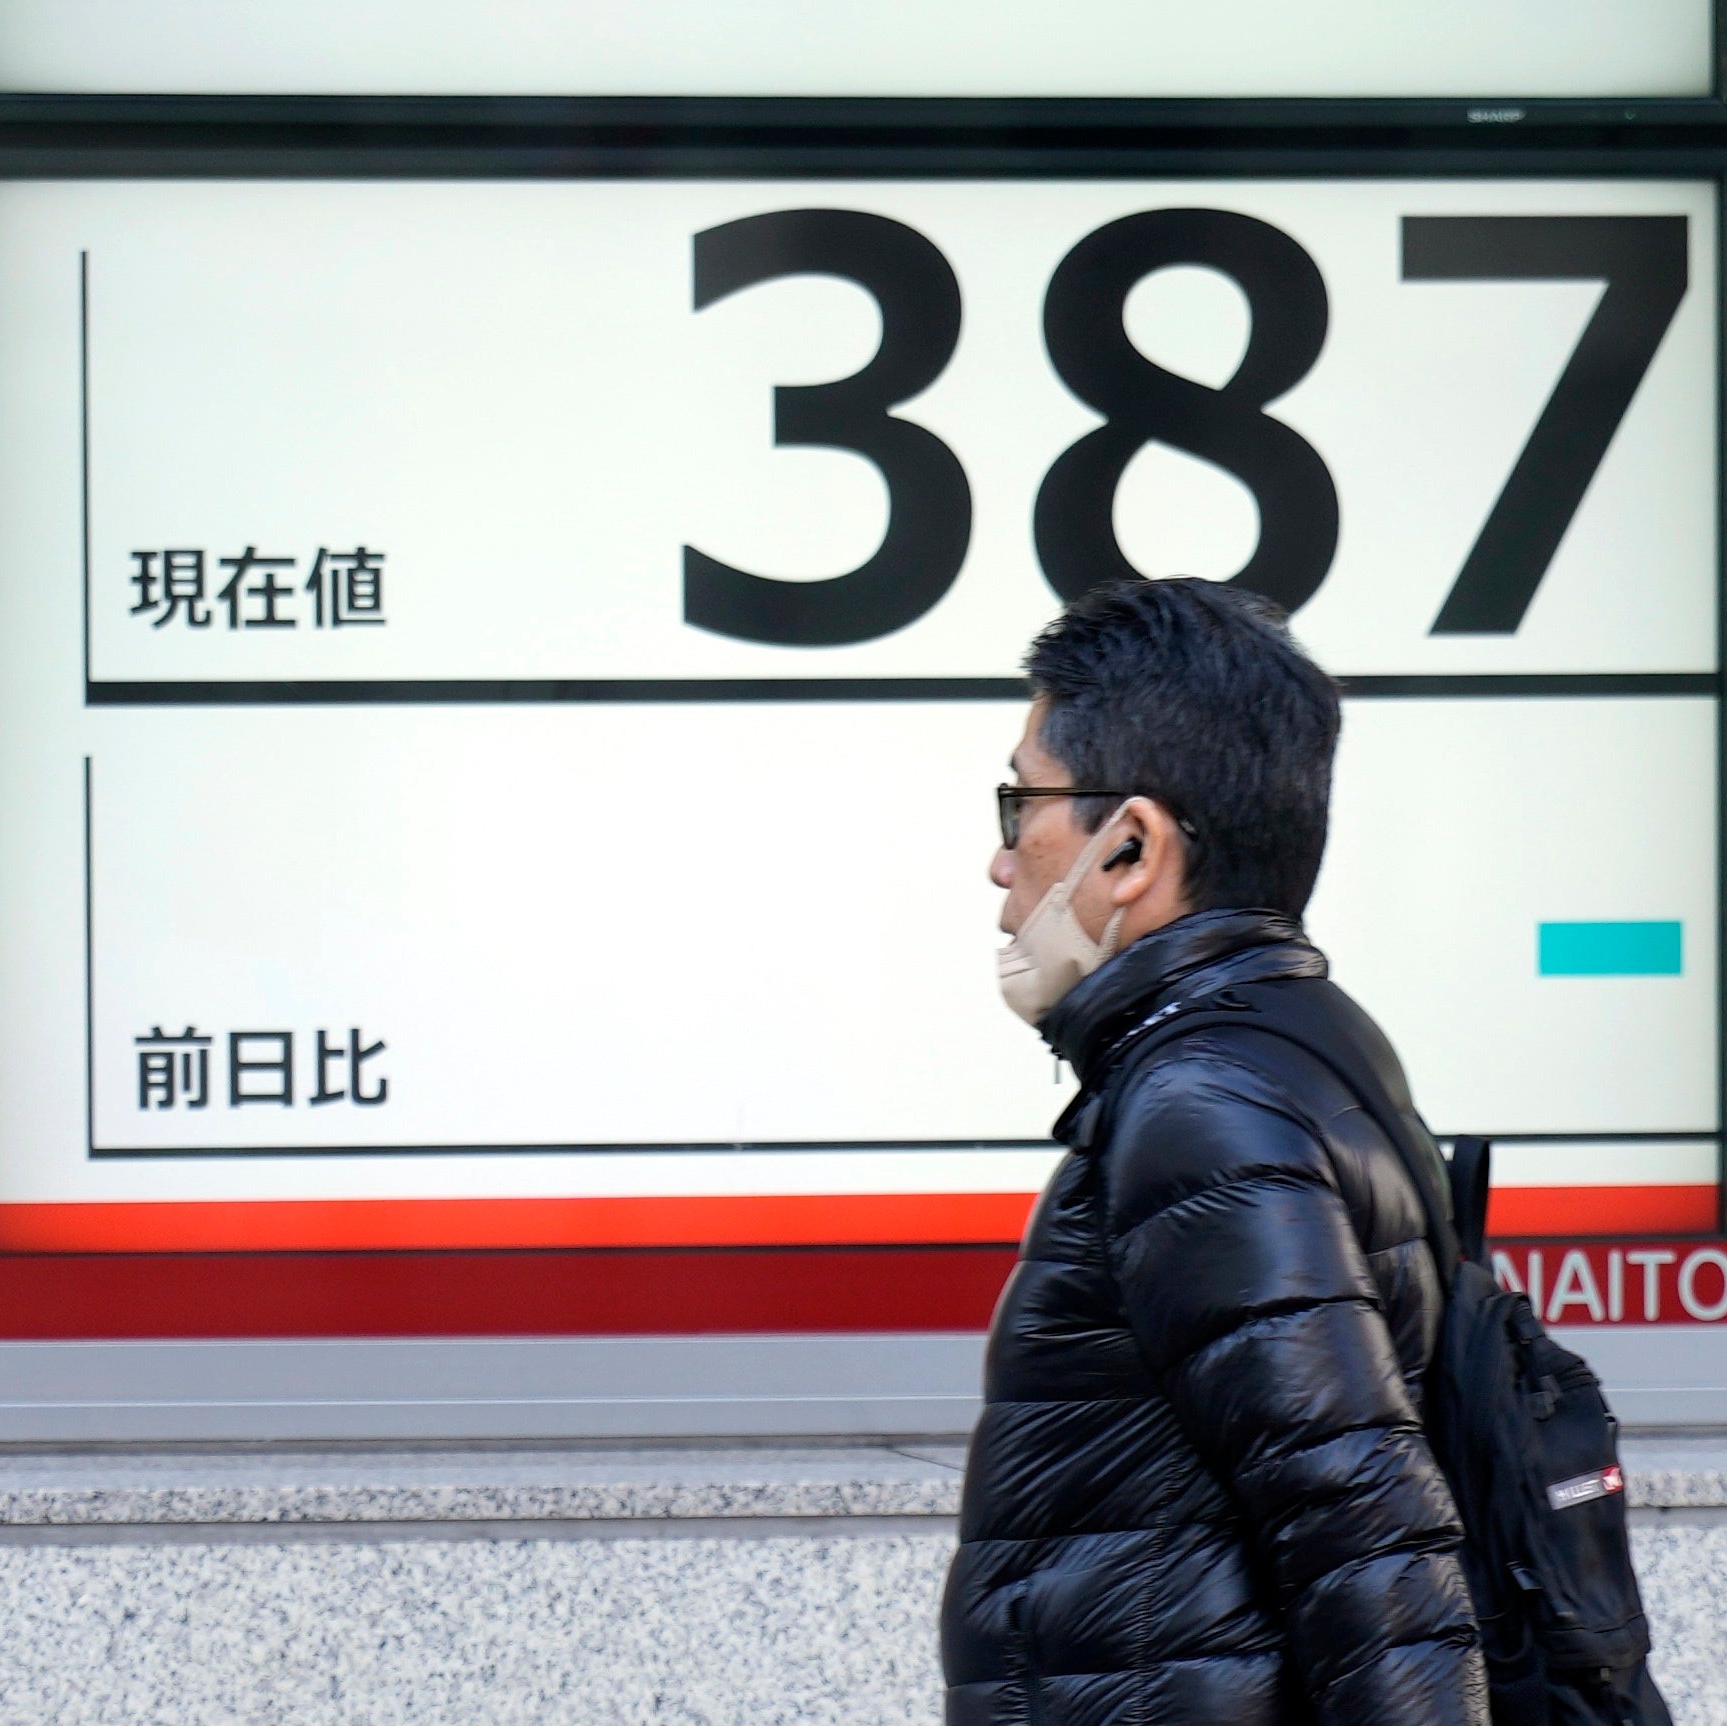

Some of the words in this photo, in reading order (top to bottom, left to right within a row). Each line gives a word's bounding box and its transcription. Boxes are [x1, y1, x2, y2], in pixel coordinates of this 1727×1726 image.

[128, 545, 389, 631] 現在値
[134, 1025, 390, 1110] 前日比
